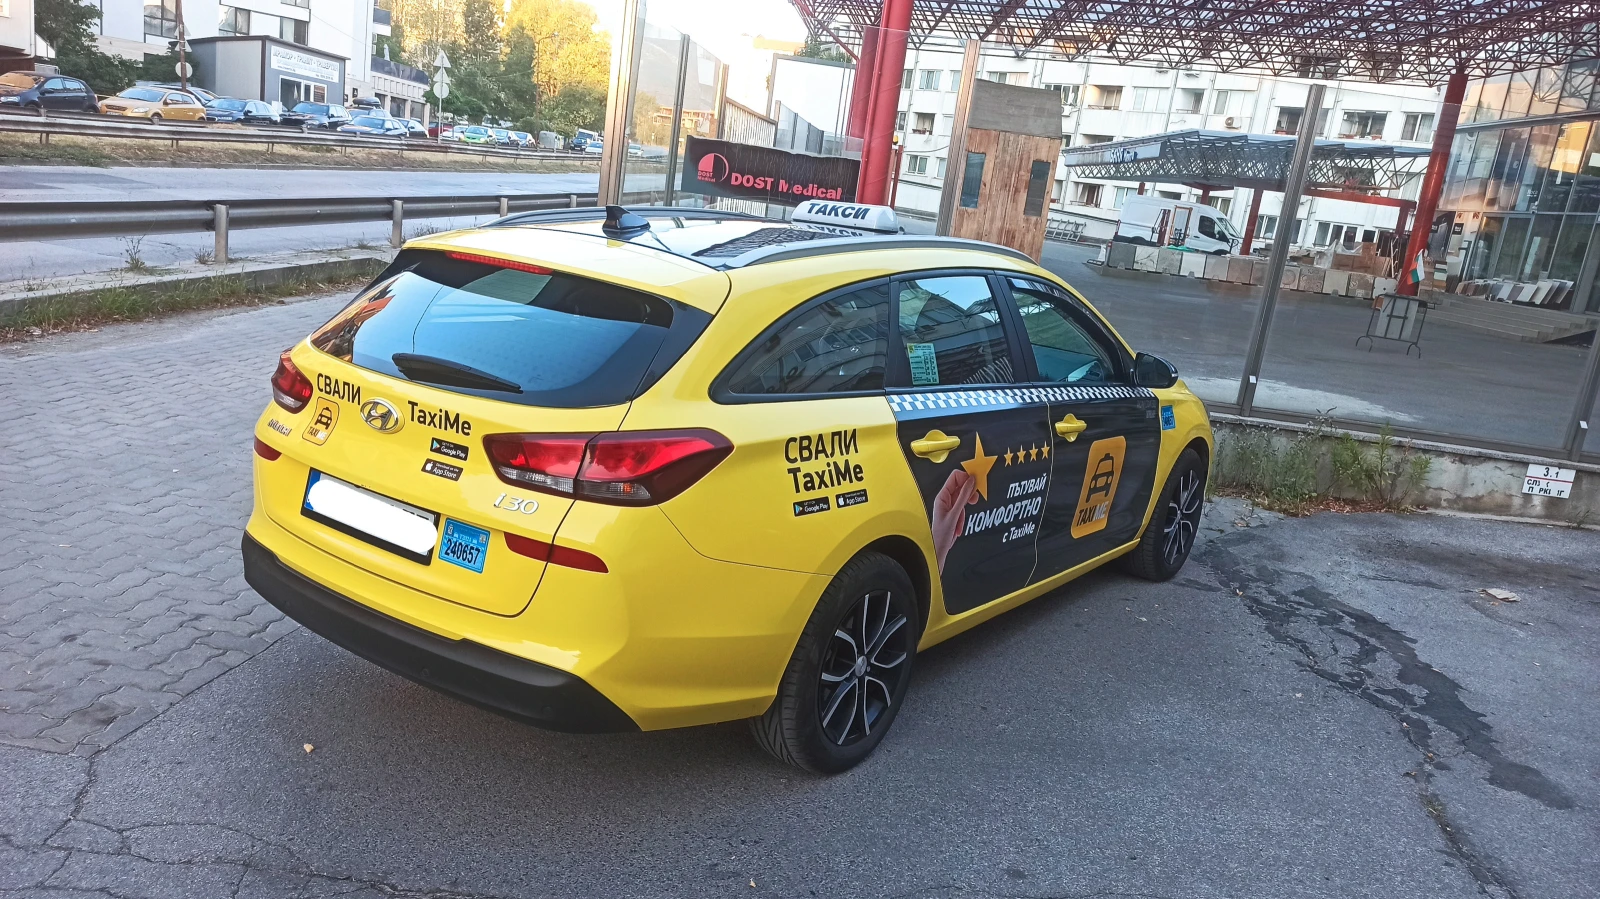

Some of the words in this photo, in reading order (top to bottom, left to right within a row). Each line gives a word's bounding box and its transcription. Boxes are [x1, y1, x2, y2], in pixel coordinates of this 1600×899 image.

[731, 173, 774, 190] DOST
[806, 203, 871, 220] ТАКСИ
[317, 373, 361, 405] СВАЛИ
[408, 400, 472, 436] TaxiMe
[441, 446, 457, 456] Google
[457, 450, 466, 458] Play
[785, 428, 858, 464] СВАЛИ
[443, 470, 457, 478] Store
[787, 459, 864, 494] TaxiMe
[1007, 473, 1047, 499] ПЪТУВАЙ
[493, 492, 539, 515] i30
[804, 504, 820, 512] Google
[965, 496, 1042, 536] КОМФОРТНО
[1077, 501, 1109, 527] TAXIME
[1009, 521, 1036, 541] TaxiMe
[444, 538, 481, 565] 240657
